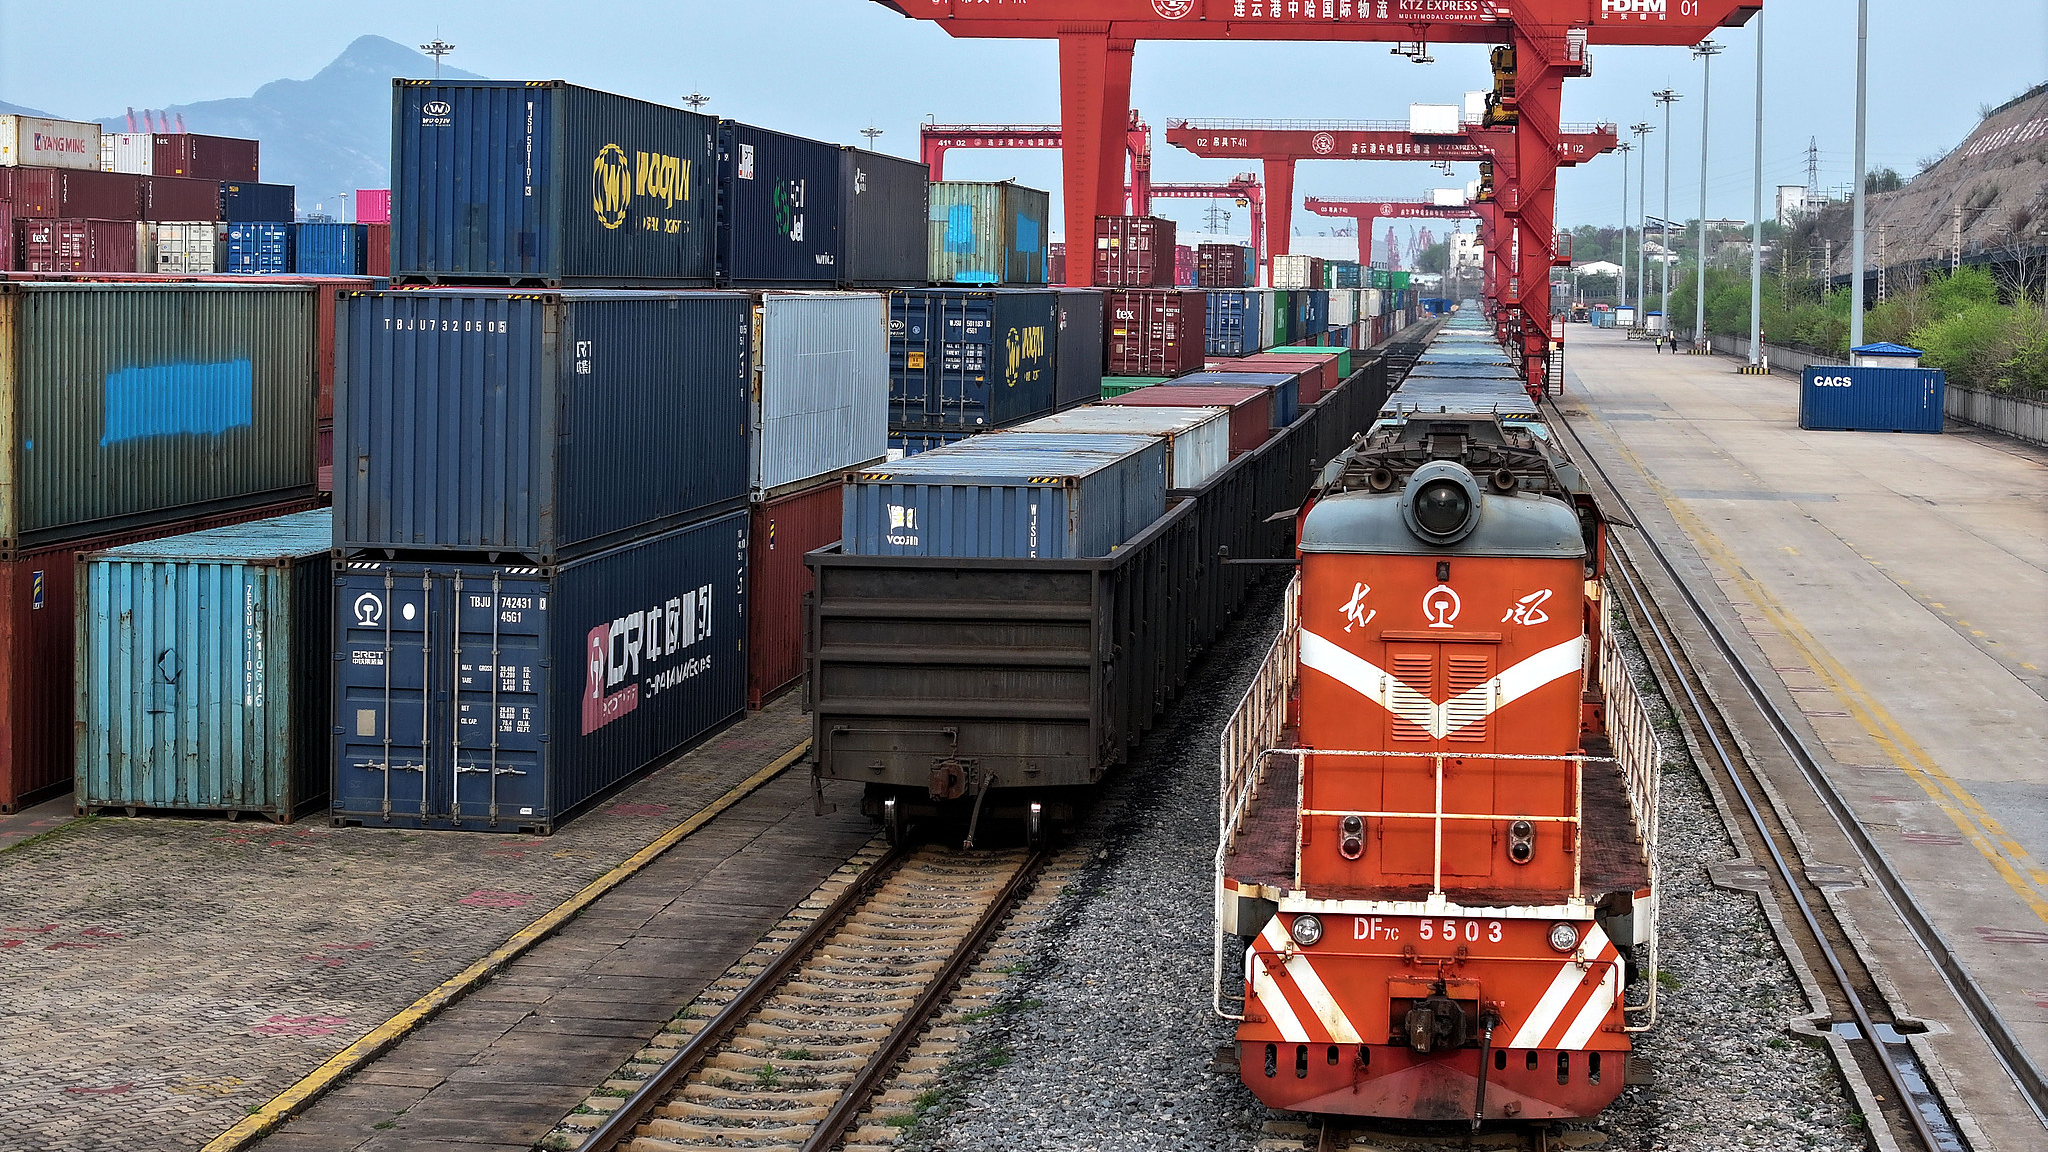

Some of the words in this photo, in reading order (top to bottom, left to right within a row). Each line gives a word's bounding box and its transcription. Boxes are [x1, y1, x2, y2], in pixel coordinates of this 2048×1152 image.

[1400, 0, 1423, 10] KTZ
[1427, 0, 1477, 10] EXPRESS
[1681, 0, 1698, 16] 01
[42, 135, 64, 151] YANG
[1197, 138, 1207, 147] 02
[32, 233, 48, 242] tex
[1116, 308, 1134, 319] tex
[1813, 376, 1852, 387] CACS
[470, 596, 490, 607] TBJU
[501, 597, 531, 609] 742431
[501, 612, 521, 623] 45G1
[1420, 919, 1502, 943] 5503
